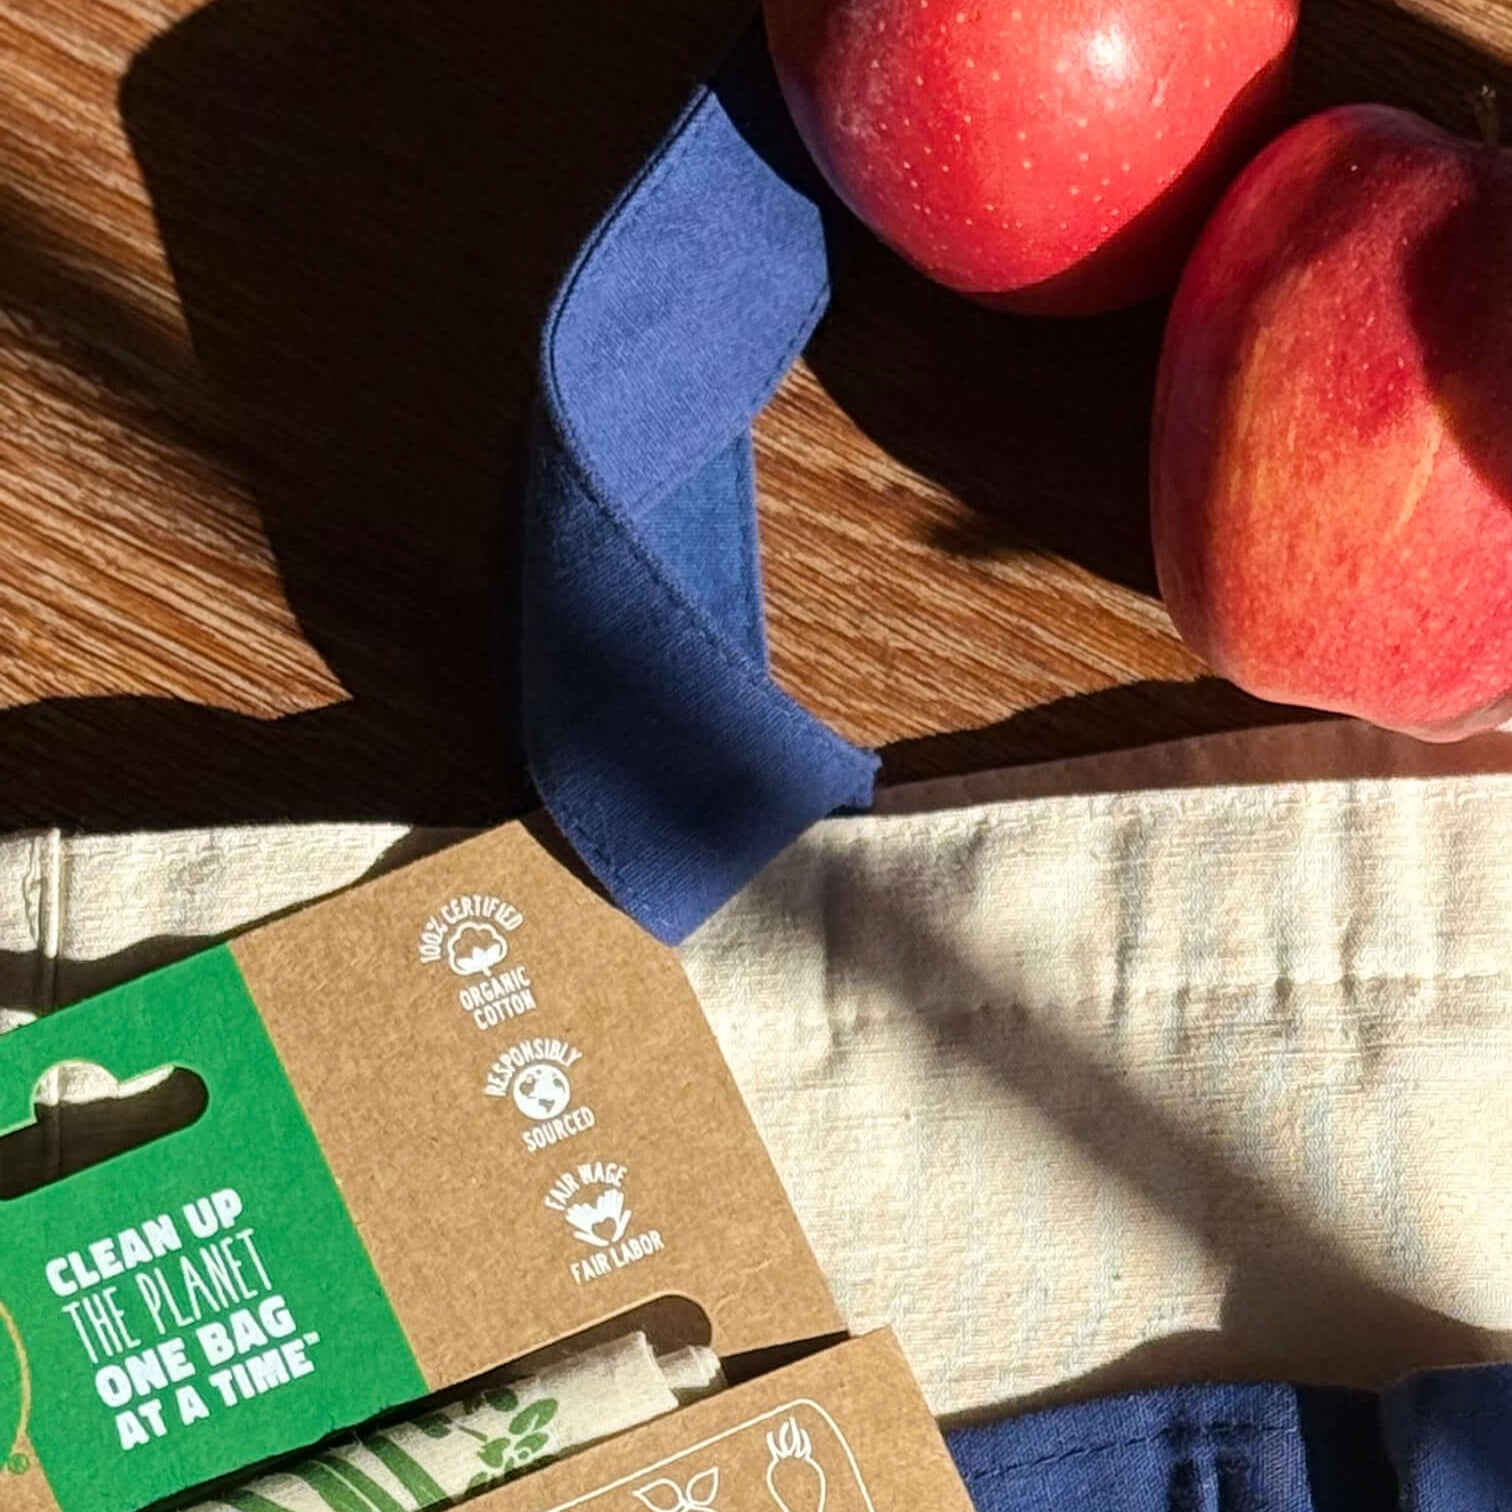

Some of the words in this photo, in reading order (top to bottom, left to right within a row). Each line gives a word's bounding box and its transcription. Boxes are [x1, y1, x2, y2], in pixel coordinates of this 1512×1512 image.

[418, 916, 447, 963] 100%
[439, 895, 525, 932] CERTIFIED
[459, 966, 532, 1011] ORGANIC
[473, 990, 536, 1030] COTTON
[485, 1038, 582, 1097] RESPONSIBLY
[522, 1106, 596, 1152] SOURCED
[545, 1168, 581, 1211] FAIR
[577, 1162, 628, 1188] WAGE
[45, 1213, 182, 1297] CLEAN
[182, 1188, 243, 1238] UP
[569, 1256, 612, 1285] FAIR
[611, 1230, 664, 1267] LABOR
[61, 1286, 141, 1363] THE
[136, 1229, 272, 1335] PLANET
[95, 1337, 196, 1408] ONE
[195, 1295, 296, 1366] BAG
[115, 1399, 168, 1451] AT
[175, 1385, 210, 1425] A
